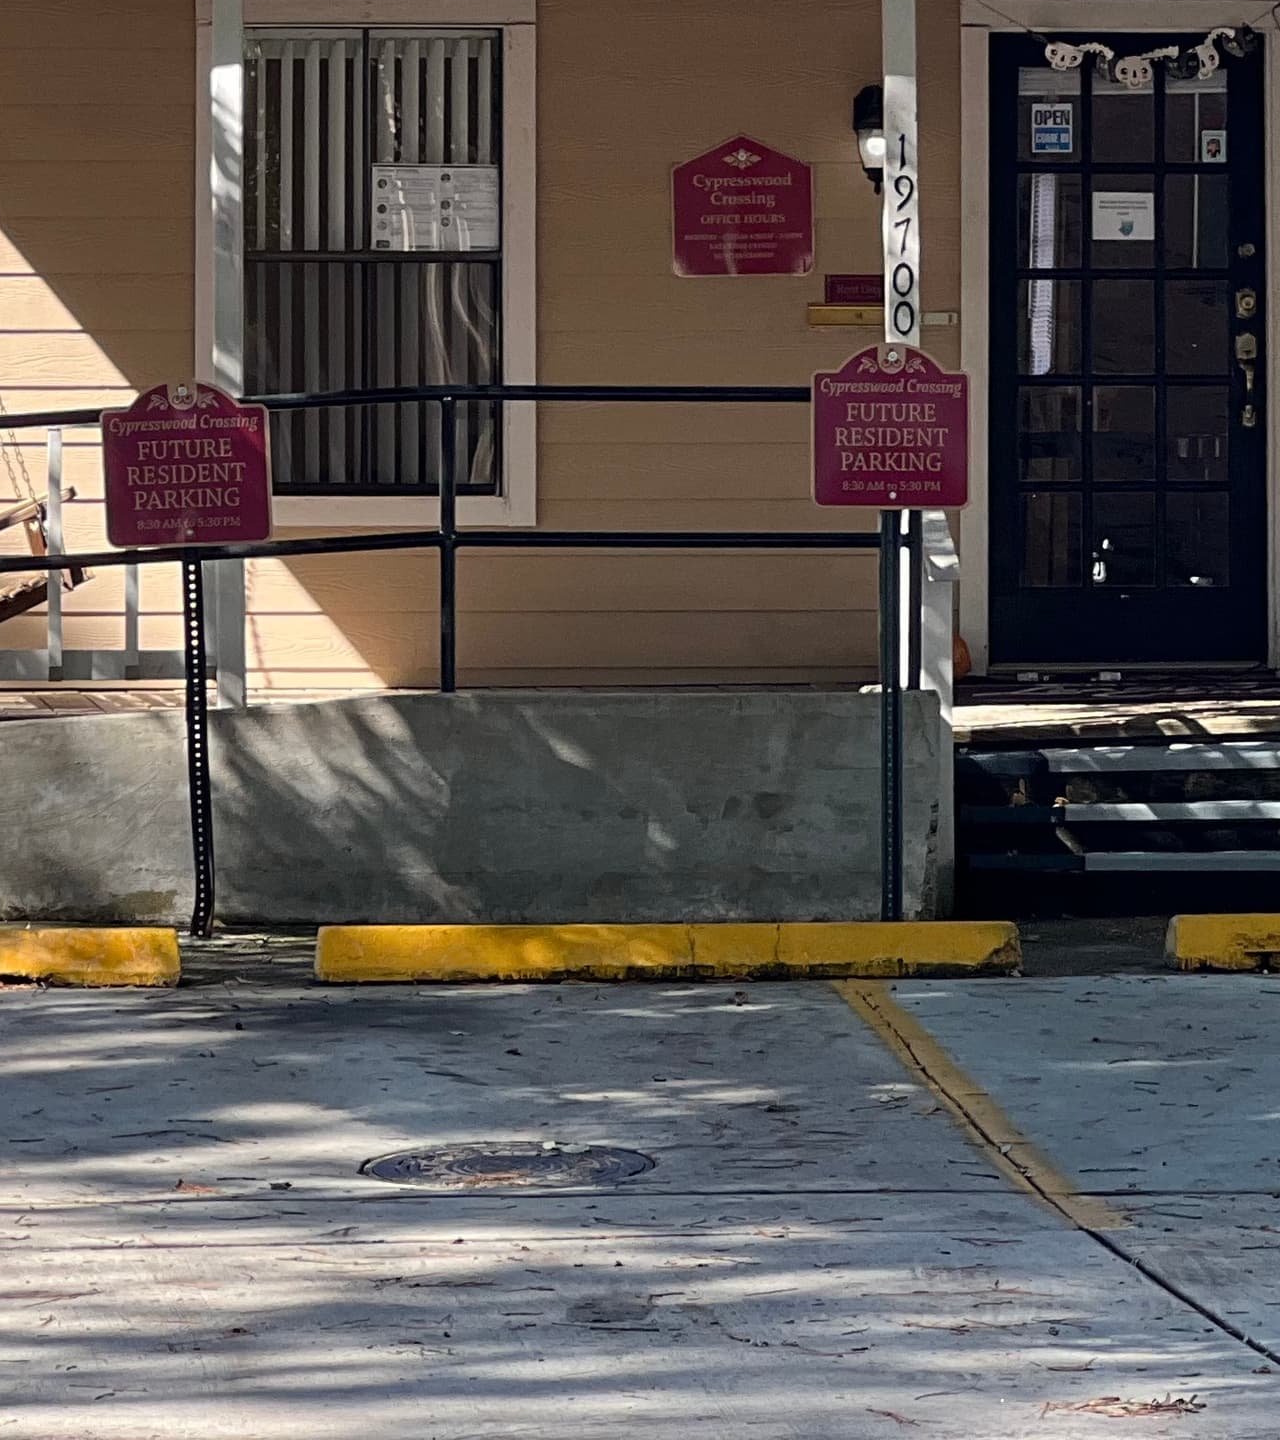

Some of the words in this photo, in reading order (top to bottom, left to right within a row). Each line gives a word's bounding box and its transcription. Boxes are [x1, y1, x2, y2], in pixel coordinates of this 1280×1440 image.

[1034, 110, 1070, 126] OPEN
[693, 171, 793, 191] Cypresswood
[710, 191, 776, 208] Crossing
[700, 214, 741, 225] OFFICE
[744, 213, 787, 224] HOURS
[892, 133, 915, 336] 19700
[820, 378, 904, 397] Cypresswood
[906, 378, 962, 399] Crossing
[845, 402, 937, 422] FUTURE
[109, 414, 197, 436] Cypresswood
[199, 413, 260, 432] Crossing
[834, 427, 949, 447] RESIDENT
[136, 437, 233, 461] FUTURE
[840, 451, 942, 472] PARKING
[126, 461, 247, 487] RESIDENT
[842, 481, 865, 491] 8:30
[866, 481, 885, 491] AM
[899, 481, 922, 491] 5:30
[924, 481, 941, 492] PM
[133, 486, 241, 511] PARKING
[162, 518, 182, 529] AM
[222, 516, 241, 527] PM
